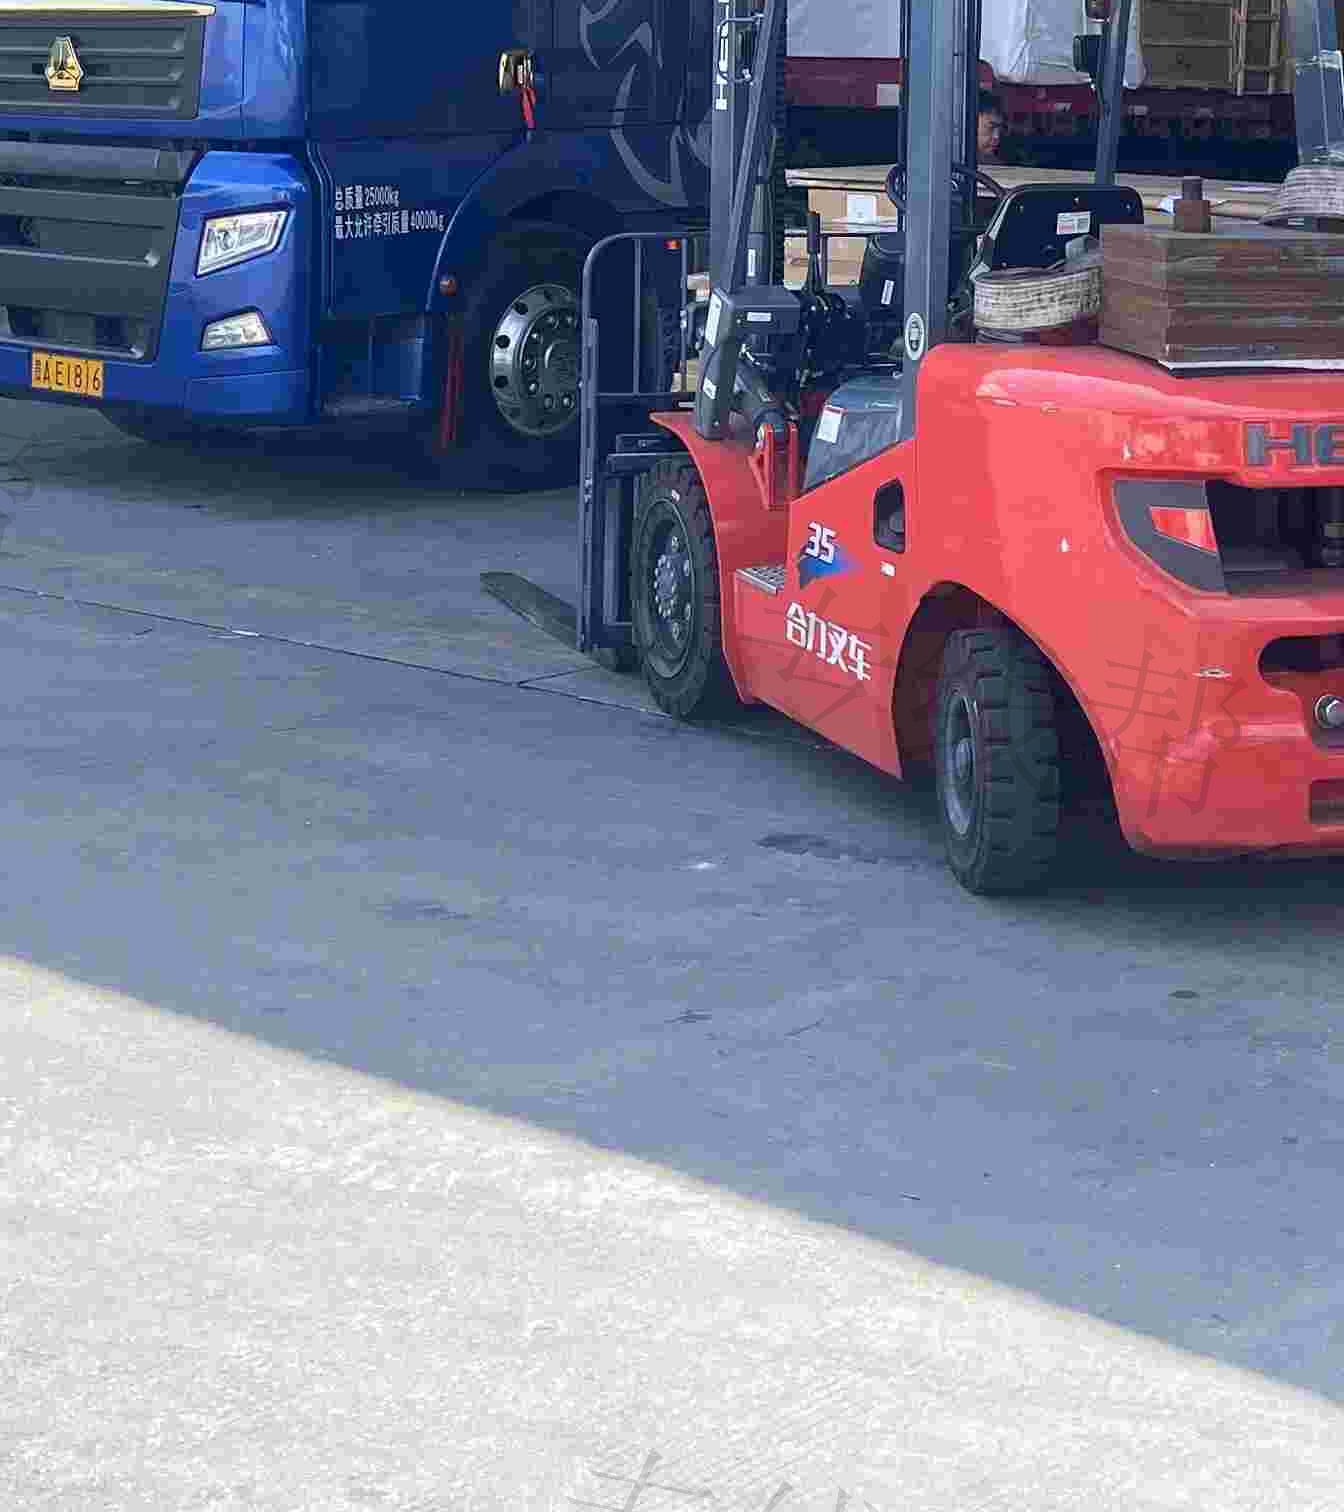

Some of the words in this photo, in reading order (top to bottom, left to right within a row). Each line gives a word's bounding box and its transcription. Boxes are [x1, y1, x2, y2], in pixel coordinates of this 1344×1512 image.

[805, 520, 838, 565] 35
[785, 600, 873, 681] 合力叉车
